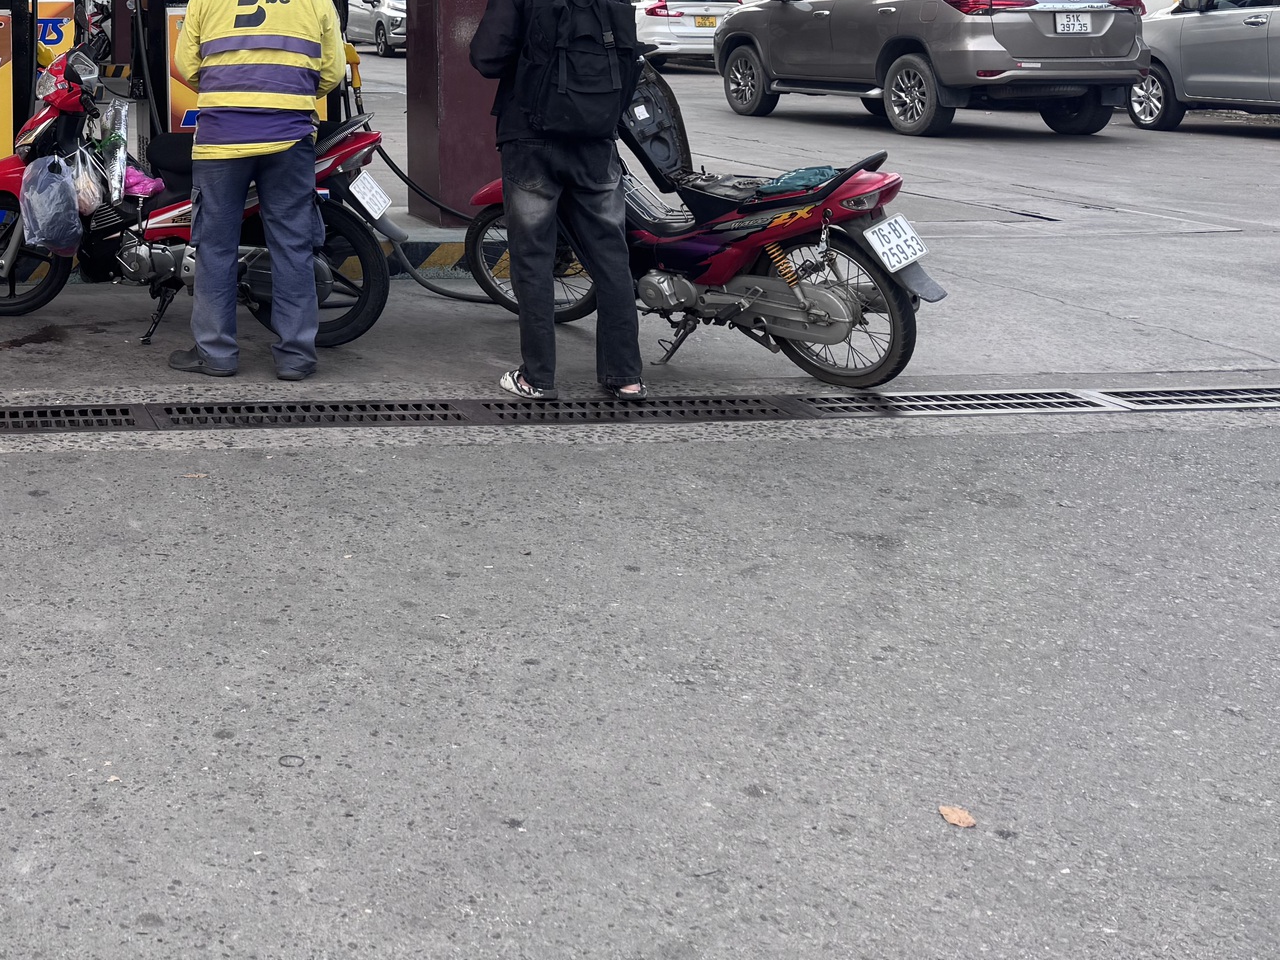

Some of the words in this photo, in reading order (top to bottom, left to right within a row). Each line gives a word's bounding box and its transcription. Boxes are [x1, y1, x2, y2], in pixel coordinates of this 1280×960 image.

[1060, 23, 1088, 32] 397.35
[1066, 14, 1080, 23] 51K
[871, 218, 907, 248] 76-B1
[881, 236, 924, 269] 259.53
